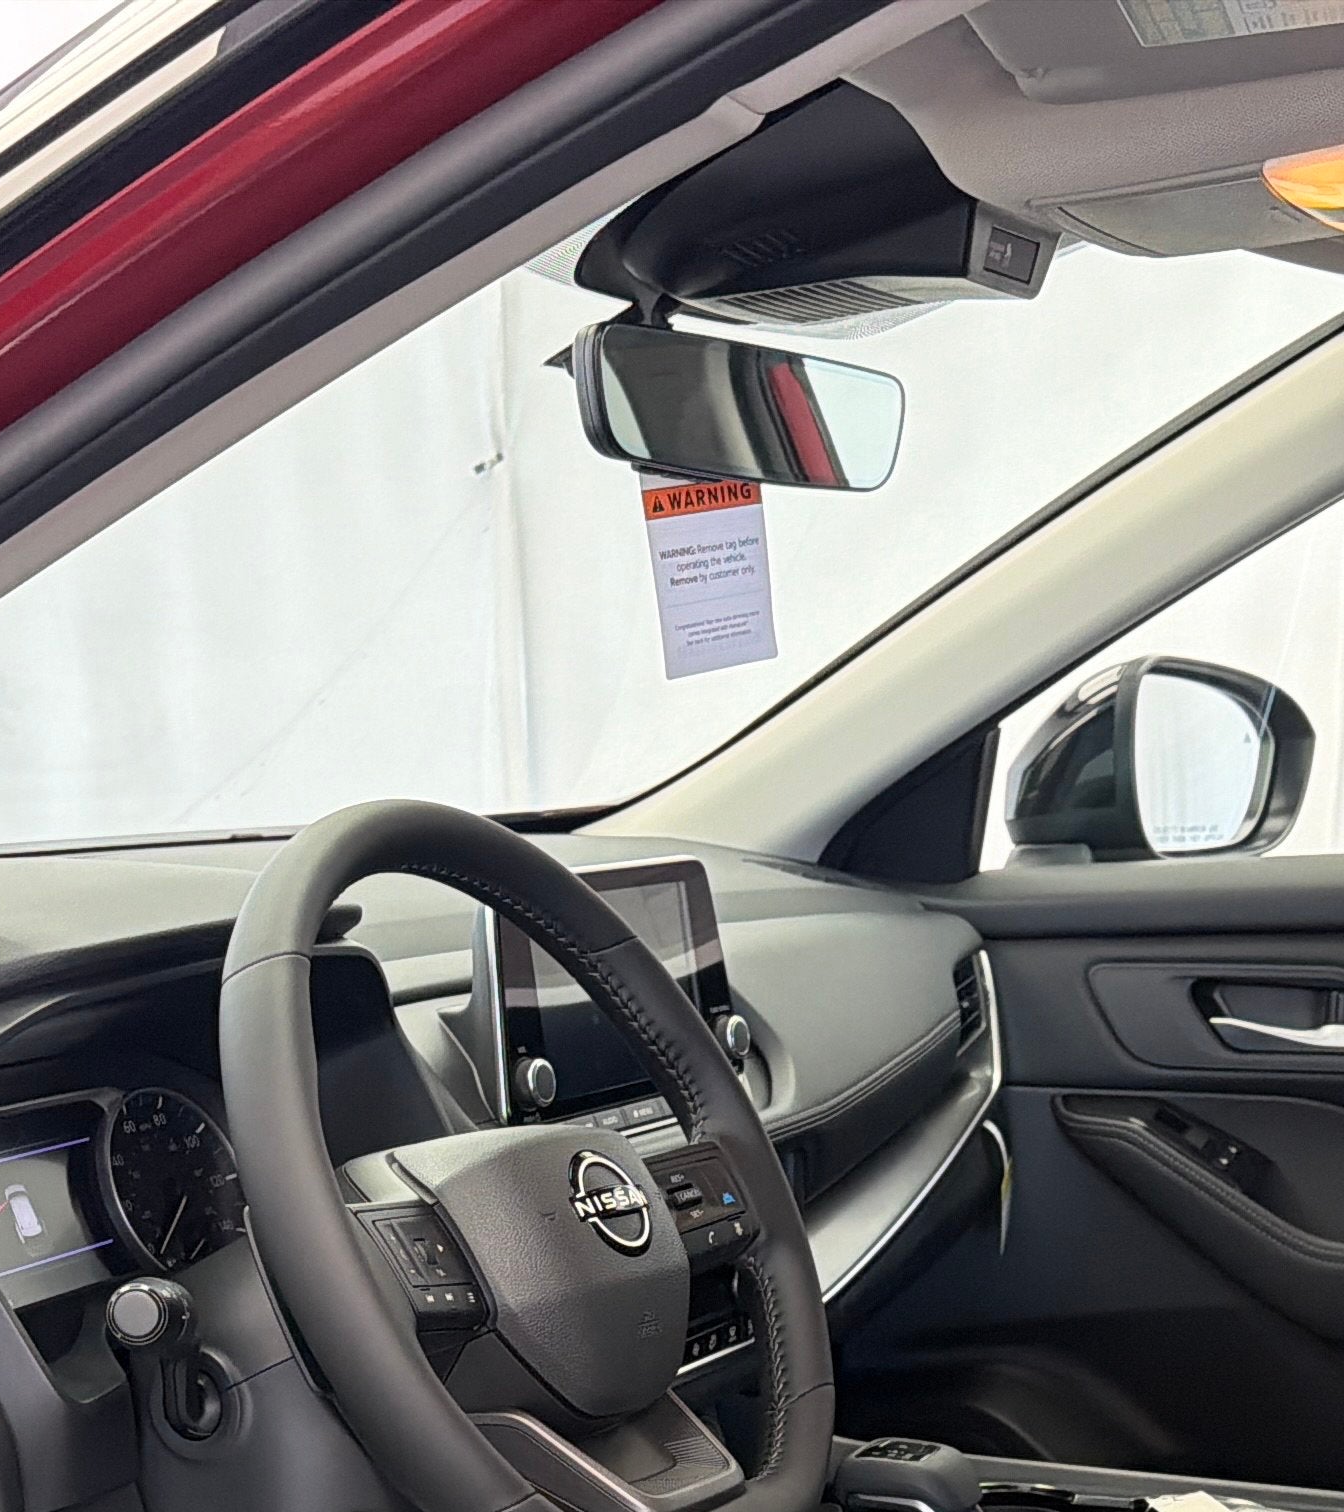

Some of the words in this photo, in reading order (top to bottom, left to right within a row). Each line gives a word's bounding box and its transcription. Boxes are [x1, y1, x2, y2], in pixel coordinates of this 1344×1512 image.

[667, 483, 752, 511] WARNING
[659, 545, 696, 560] WARNING:
[697, 543, 724, 553] Remove
[725, 541, 737, 551] tag
[738, 536, 760, 546] before
[676, 557, 709, 572] operating
[710, 556, 721, 566] the
[669, 575, 698, 587] Remove
[699, 574, 708, 584] by
[709, 568, 739, 580] customer
[574, 1189, 649, 1218] NISSAN
